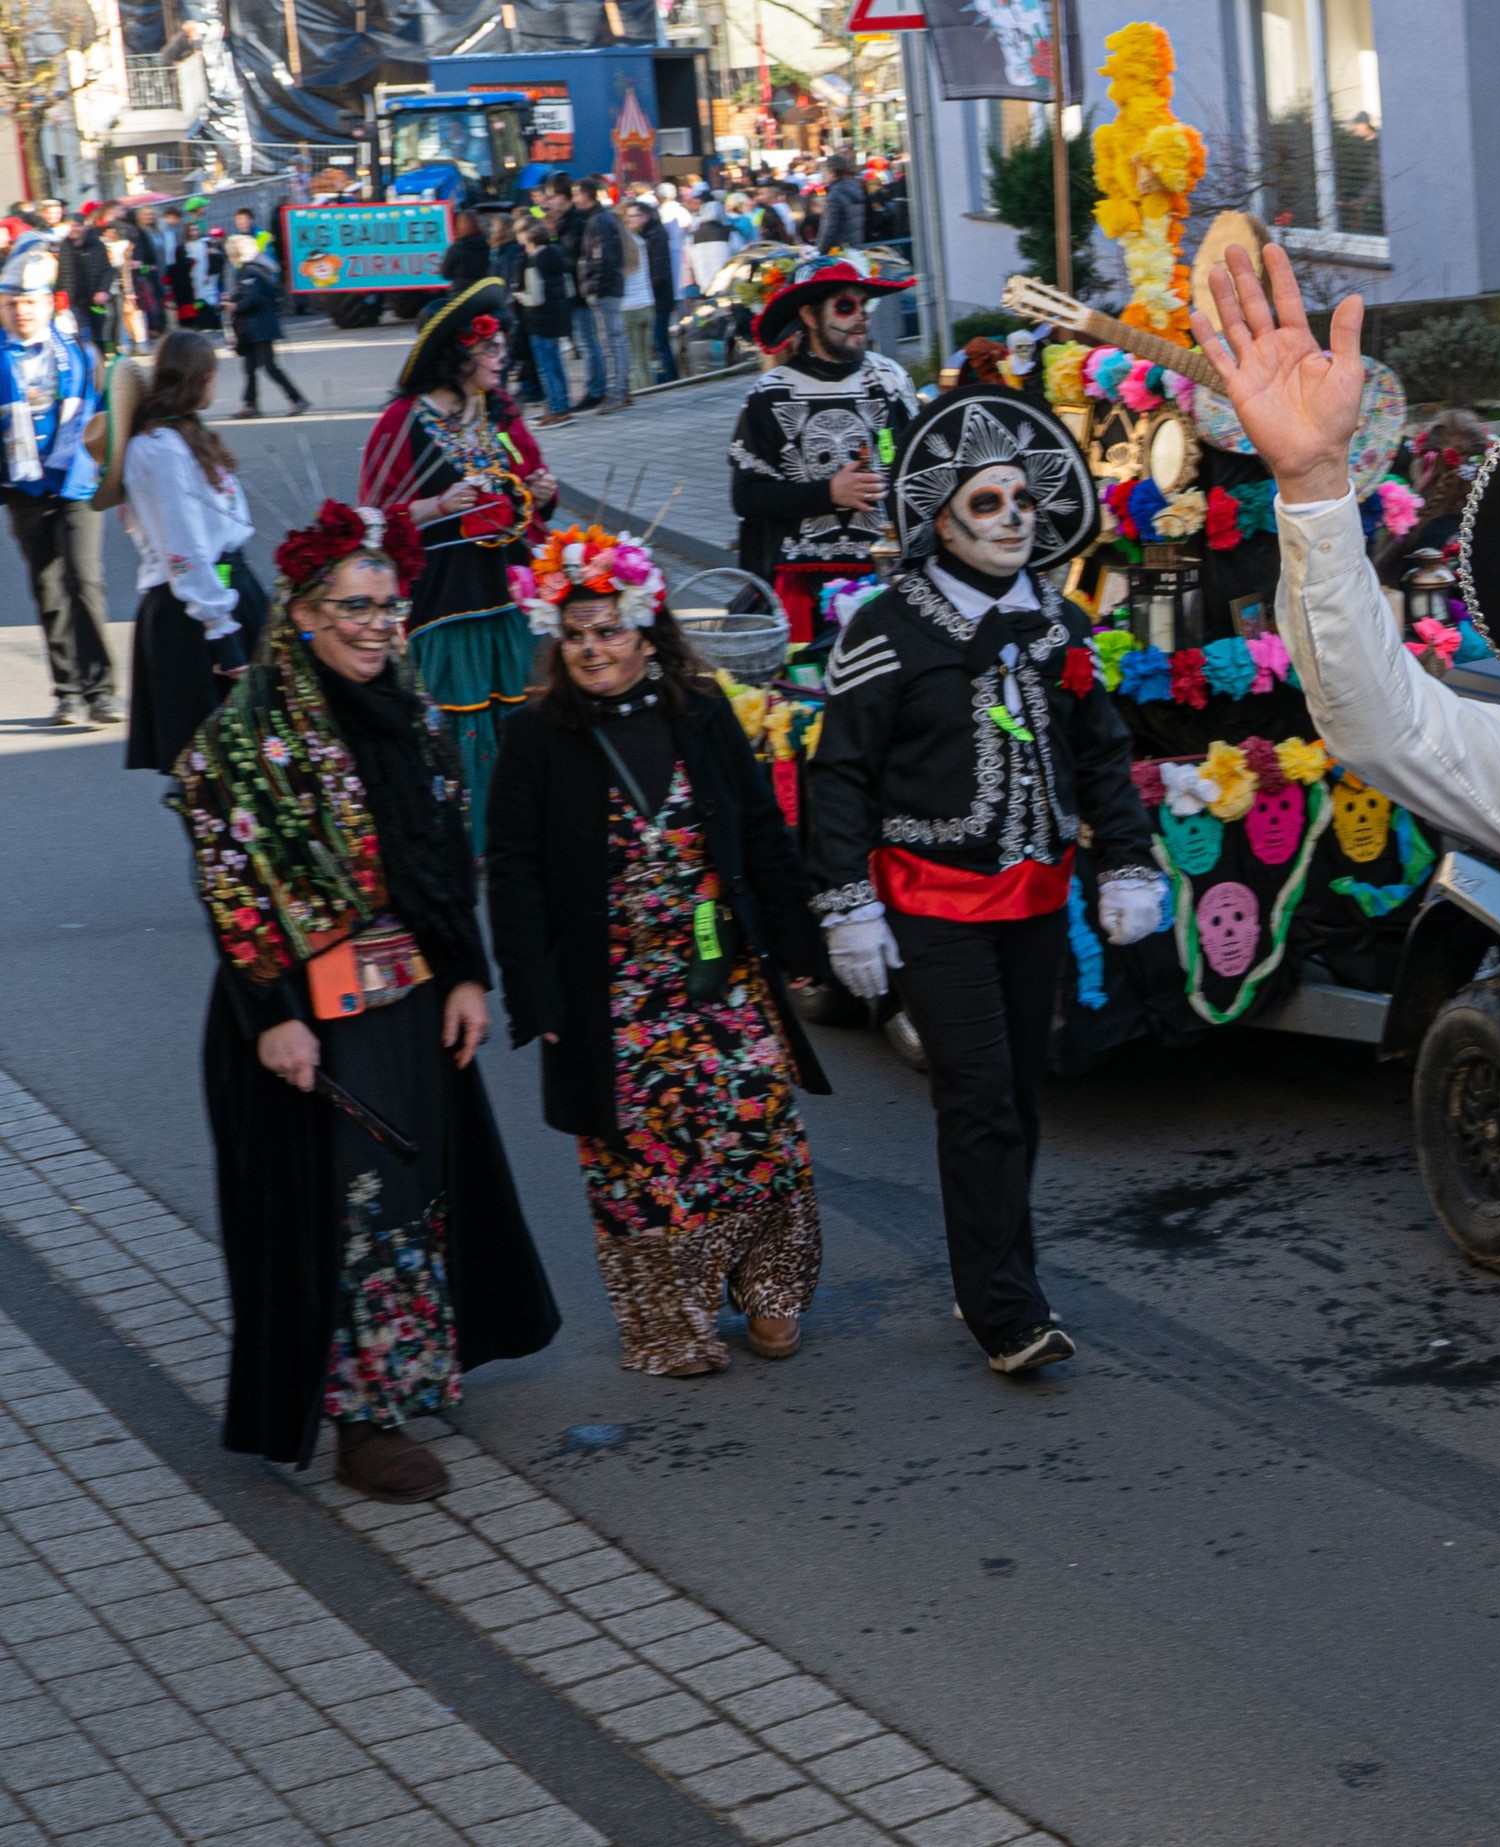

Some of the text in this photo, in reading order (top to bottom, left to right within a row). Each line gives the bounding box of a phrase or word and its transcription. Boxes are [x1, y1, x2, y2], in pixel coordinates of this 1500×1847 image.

[297, 221, 442, 247] KG BAULER
[346, 253, 444, 277] ZIRKUS
